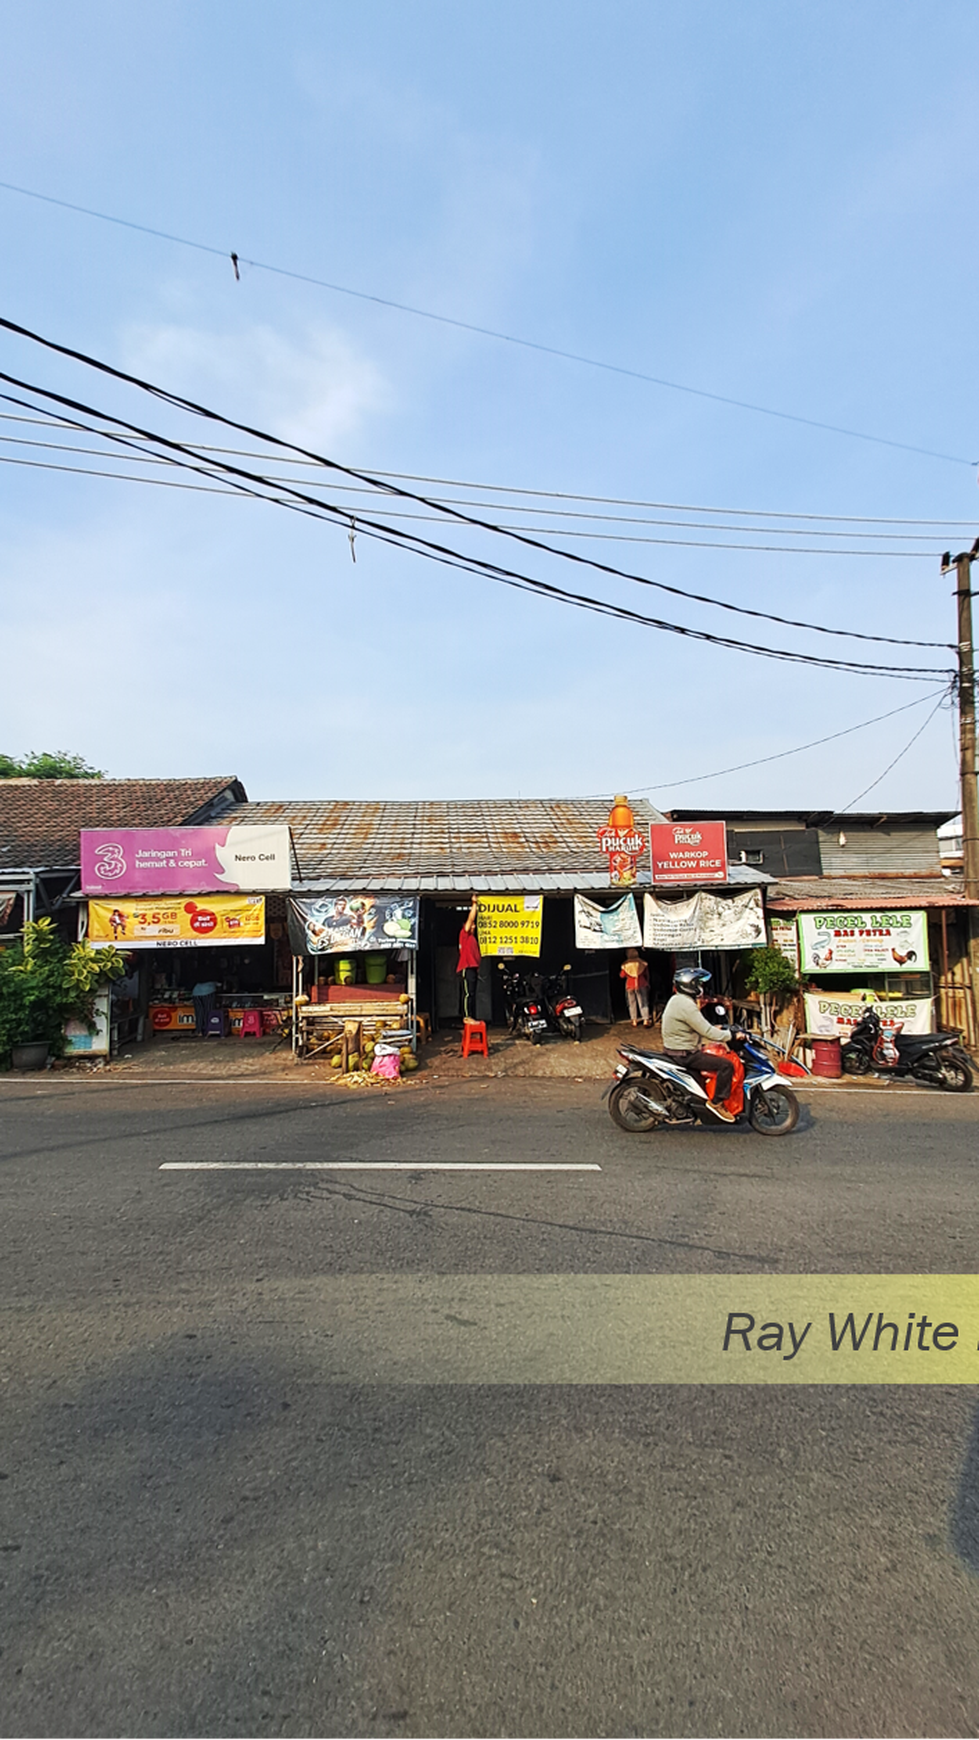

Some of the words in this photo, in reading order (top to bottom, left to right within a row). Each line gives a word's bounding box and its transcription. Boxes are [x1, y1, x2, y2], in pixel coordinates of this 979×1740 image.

[135, 849, 178, 859] Jaringan
[180, 849, 192, 857] Tri
[234, 854, 256, 862] Nero
[258, 853, 276, 861] Cell
[669, 851, 709, 859] WARKOP
[135, 859, 167, 868] hemat
[168, 860, 176, 868] &
[178, 860, 208, 869] cepat.
[657, 861, 698, 869] YELLOW
[699, 860, 722, 868] RICE
[479, 904, 520, 913] DIJUAL
[139, 912, 161, 926] 3,5
[162, 912, 178, 920] GB
[814, 916, 867, 929] PECEL
[871, 915, 912, 928] LELE
[478, 920, 498, 929] 0852
[499, 920, 519, 928] 8000
[520, 920, 540, 928] 9719
[480, 936, 498, 945] 0812
[499, 936, 518, 944] 1251
[520, 936, 539, 945] 3810
[875, 1004, 917, 1018] LELE
